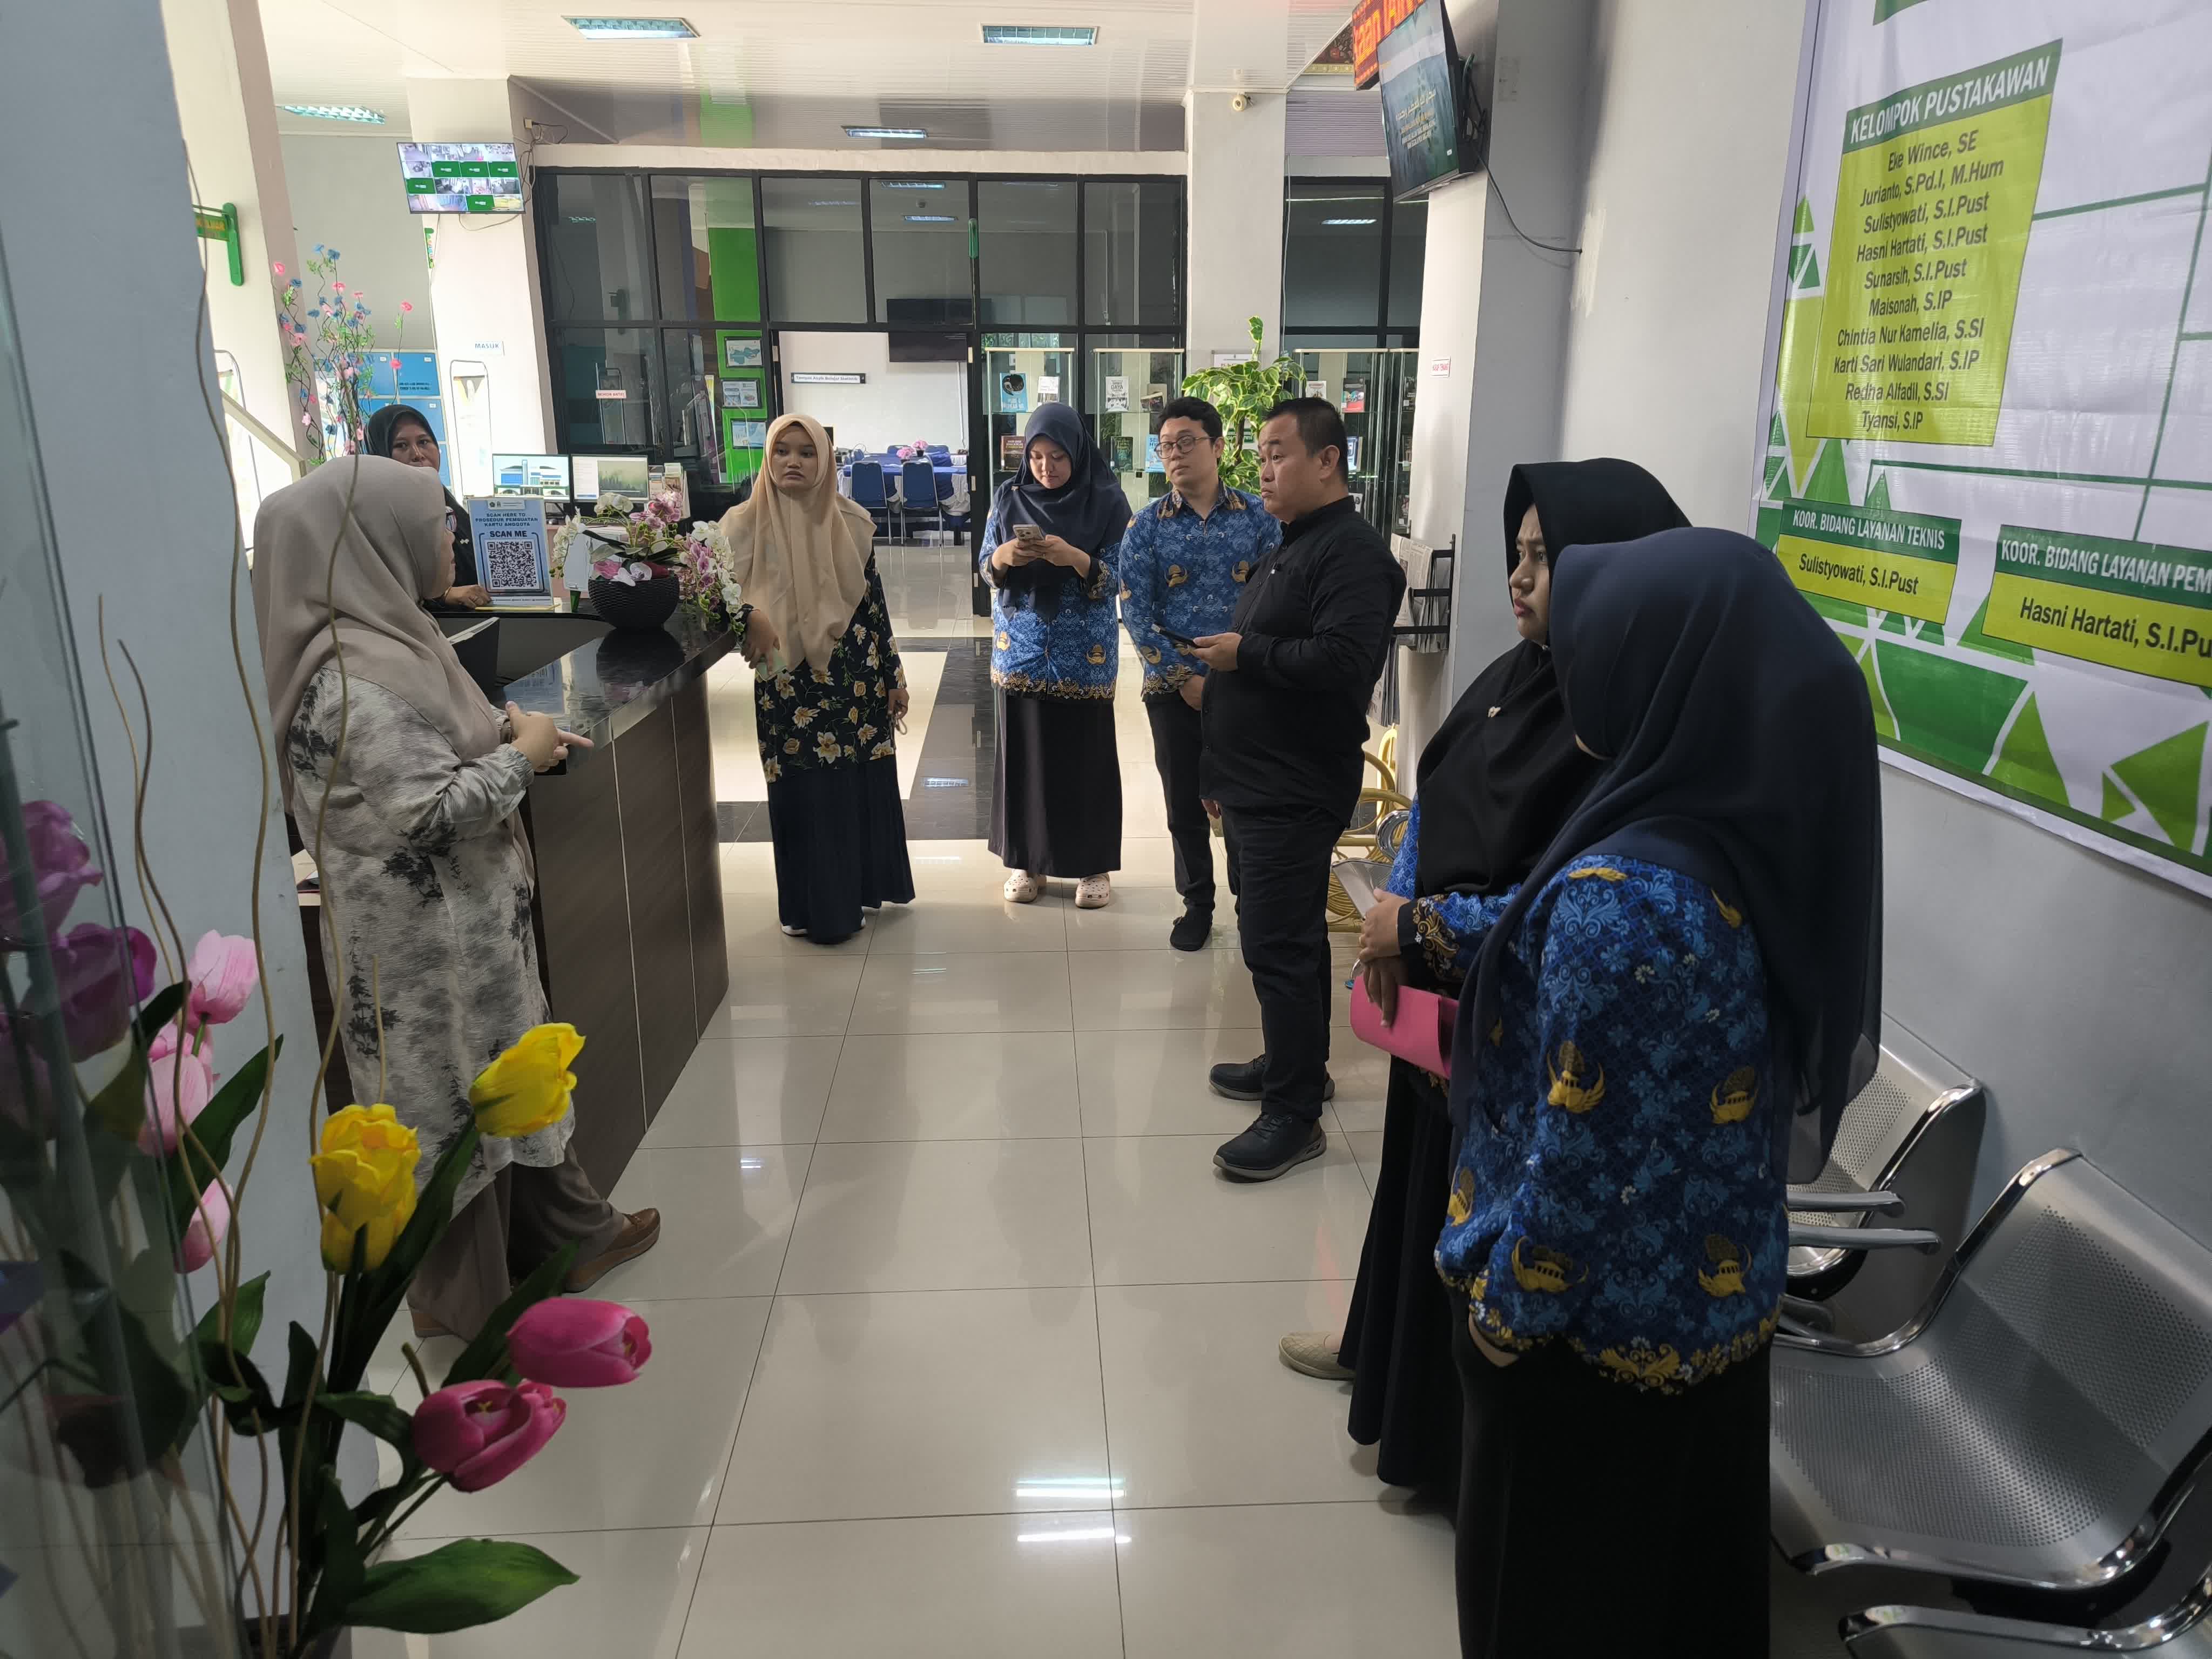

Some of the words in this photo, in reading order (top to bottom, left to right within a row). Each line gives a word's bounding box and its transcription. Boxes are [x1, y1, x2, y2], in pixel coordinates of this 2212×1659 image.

[1850, 95, 1922, 144] KELOMPOK
[1924, 56, 2050, 119] PUSTAKAWAN
[1889, 151, 1904, 172] Eke
[1908, 142, 1951, 165] Wince,
[1957, 130, 1979, 153] SE
[1860, 180, 1901, 207] Jurianto,
[1904, 170, 1945, 195] S.Pd.I,
[1951, 160, 2004, 186] M.Hum
[1863, 203, 1928, 234] Sulistyowati,
[1933, 191, 1990, 220] S.I.Pust
[1857, 241, 1887, 263] Hasni
[1890, 232, 1927, 257] Hartati,
[1933, 224, 1988, 249] S.I.Pust
[1864, 266, 1910, 290] Sunarsih,
[1913, 258, 1967, 283] S.I.Pust
[1869, 294, 1919, 316] Maisonah,
[1924, 289, 1952, 311] S.IP
[1838, 327, 1876, 347] Chintia
[1879, 326, 1897, 345] Nur
[1899, 321, 1950, 343] Kamelia,
[1954, 318, 1984, 339] S.SI
[1833, 355, 1858, 374] Karti
[1860, 354, 1885, 373] Sari
[1889, 351, 1944, 373] Wulandari,
[1950, 350, 1979, 370] S.IP
[1845, 382, 1884, 401] Redha
[1886, 382, 1920, 404] Alfadil,
[1924, 382, 1949, 401] S.SI
[1862, 410, 1900, 432] Tyansi,
[1903, 412, 1923, 429] S.IP
[1793, 510, 1817, 530] KOOR.
[1820, 514, 1855, 535] BIDANG
[1858, 518, 1905, 544] LAYANAN
[1907, 525, 1945, 550] TEKNIS
[1799, 553, 1865, 588] Sulistyowati,
[1870, 567, 1919, 595] S.I.Pust
[2001, 539, 2040, 566] KOOR.
[2045, 545, 2100, 575] BIDANG
[2101, 554, 2172, 588] LAYANAN
[2020, 597, 2069, 628] Hasni
[2071, 607, 2139, 649] Hartati,
